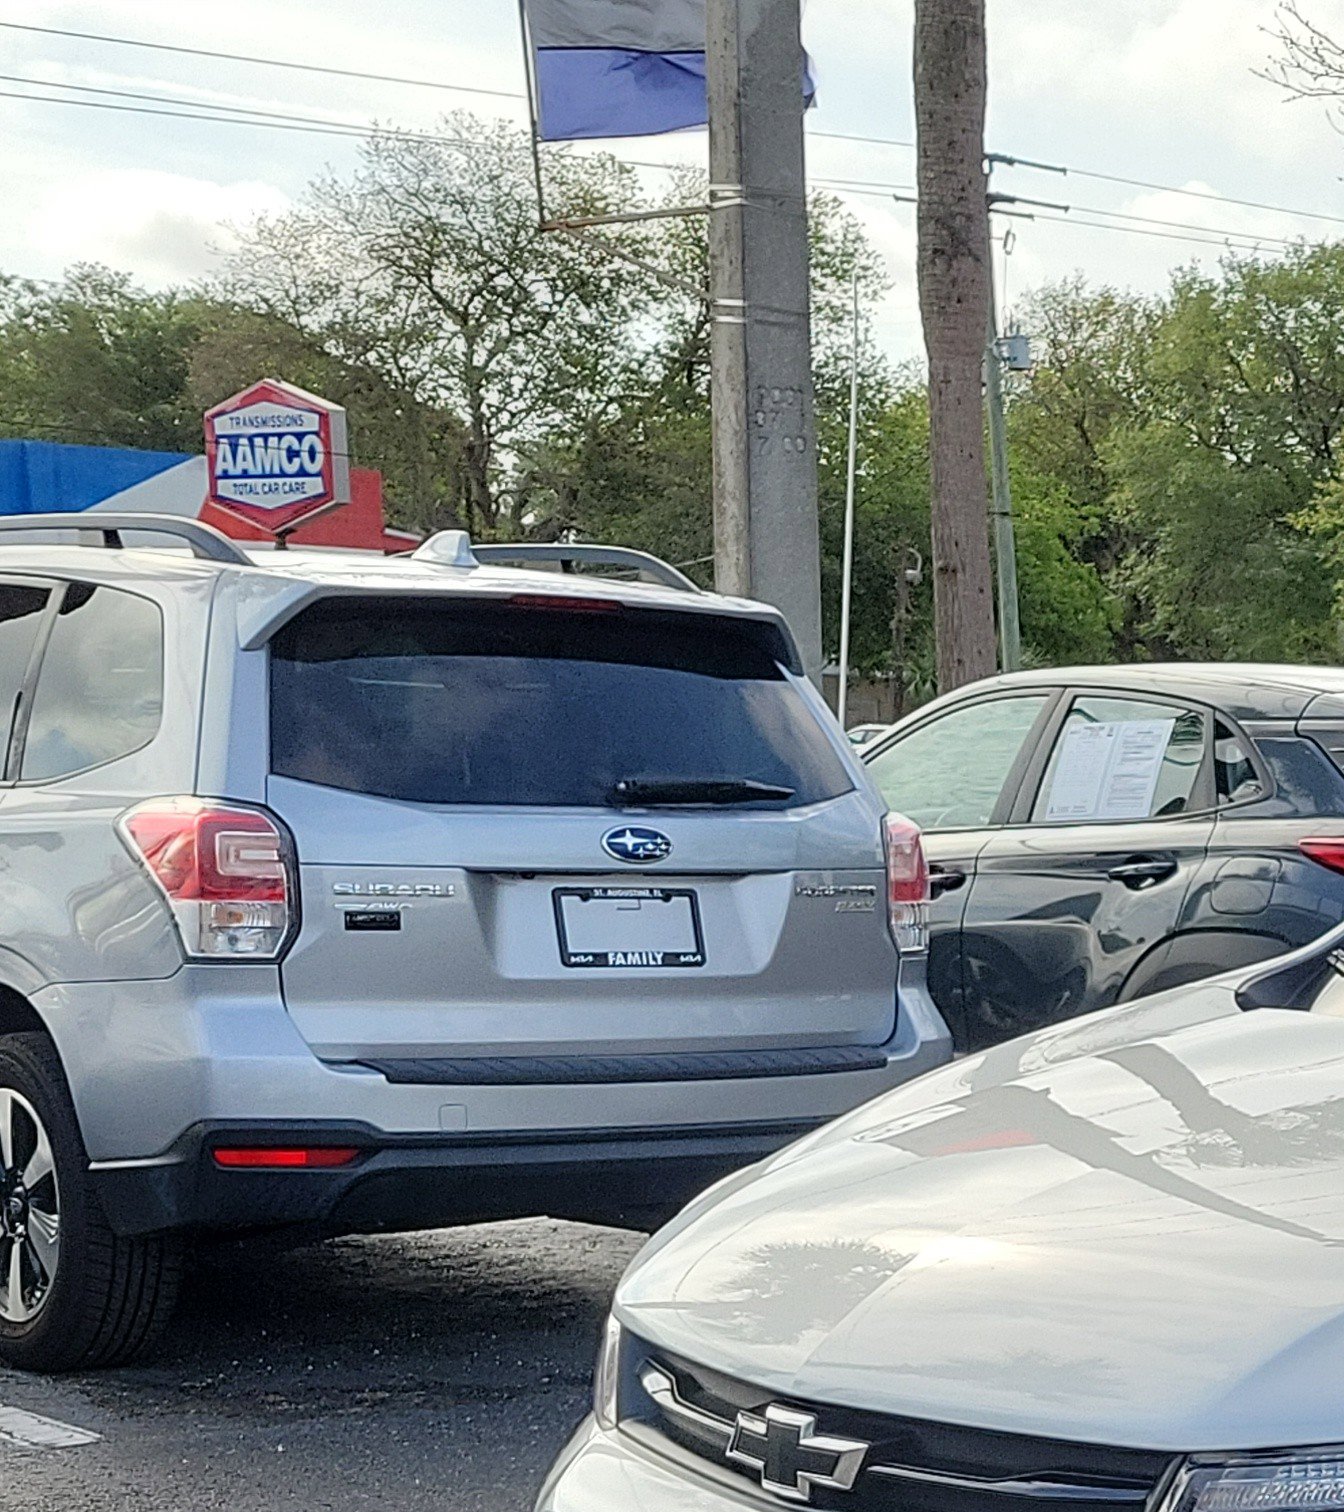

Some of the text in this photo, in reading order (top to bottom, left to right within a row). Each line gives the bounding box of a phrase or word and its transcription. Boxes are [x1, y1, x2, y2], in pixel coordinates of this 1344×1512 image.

[228, 414, 305, 428] TRANSMISSIONS
[215, 434, 324, 475] AAMCO
[232, 481, 307, 495] TOTAL CAR CARE
[333, 882, 455, 897] SUBARU
[607, 952, 664, 965] FAMILY
